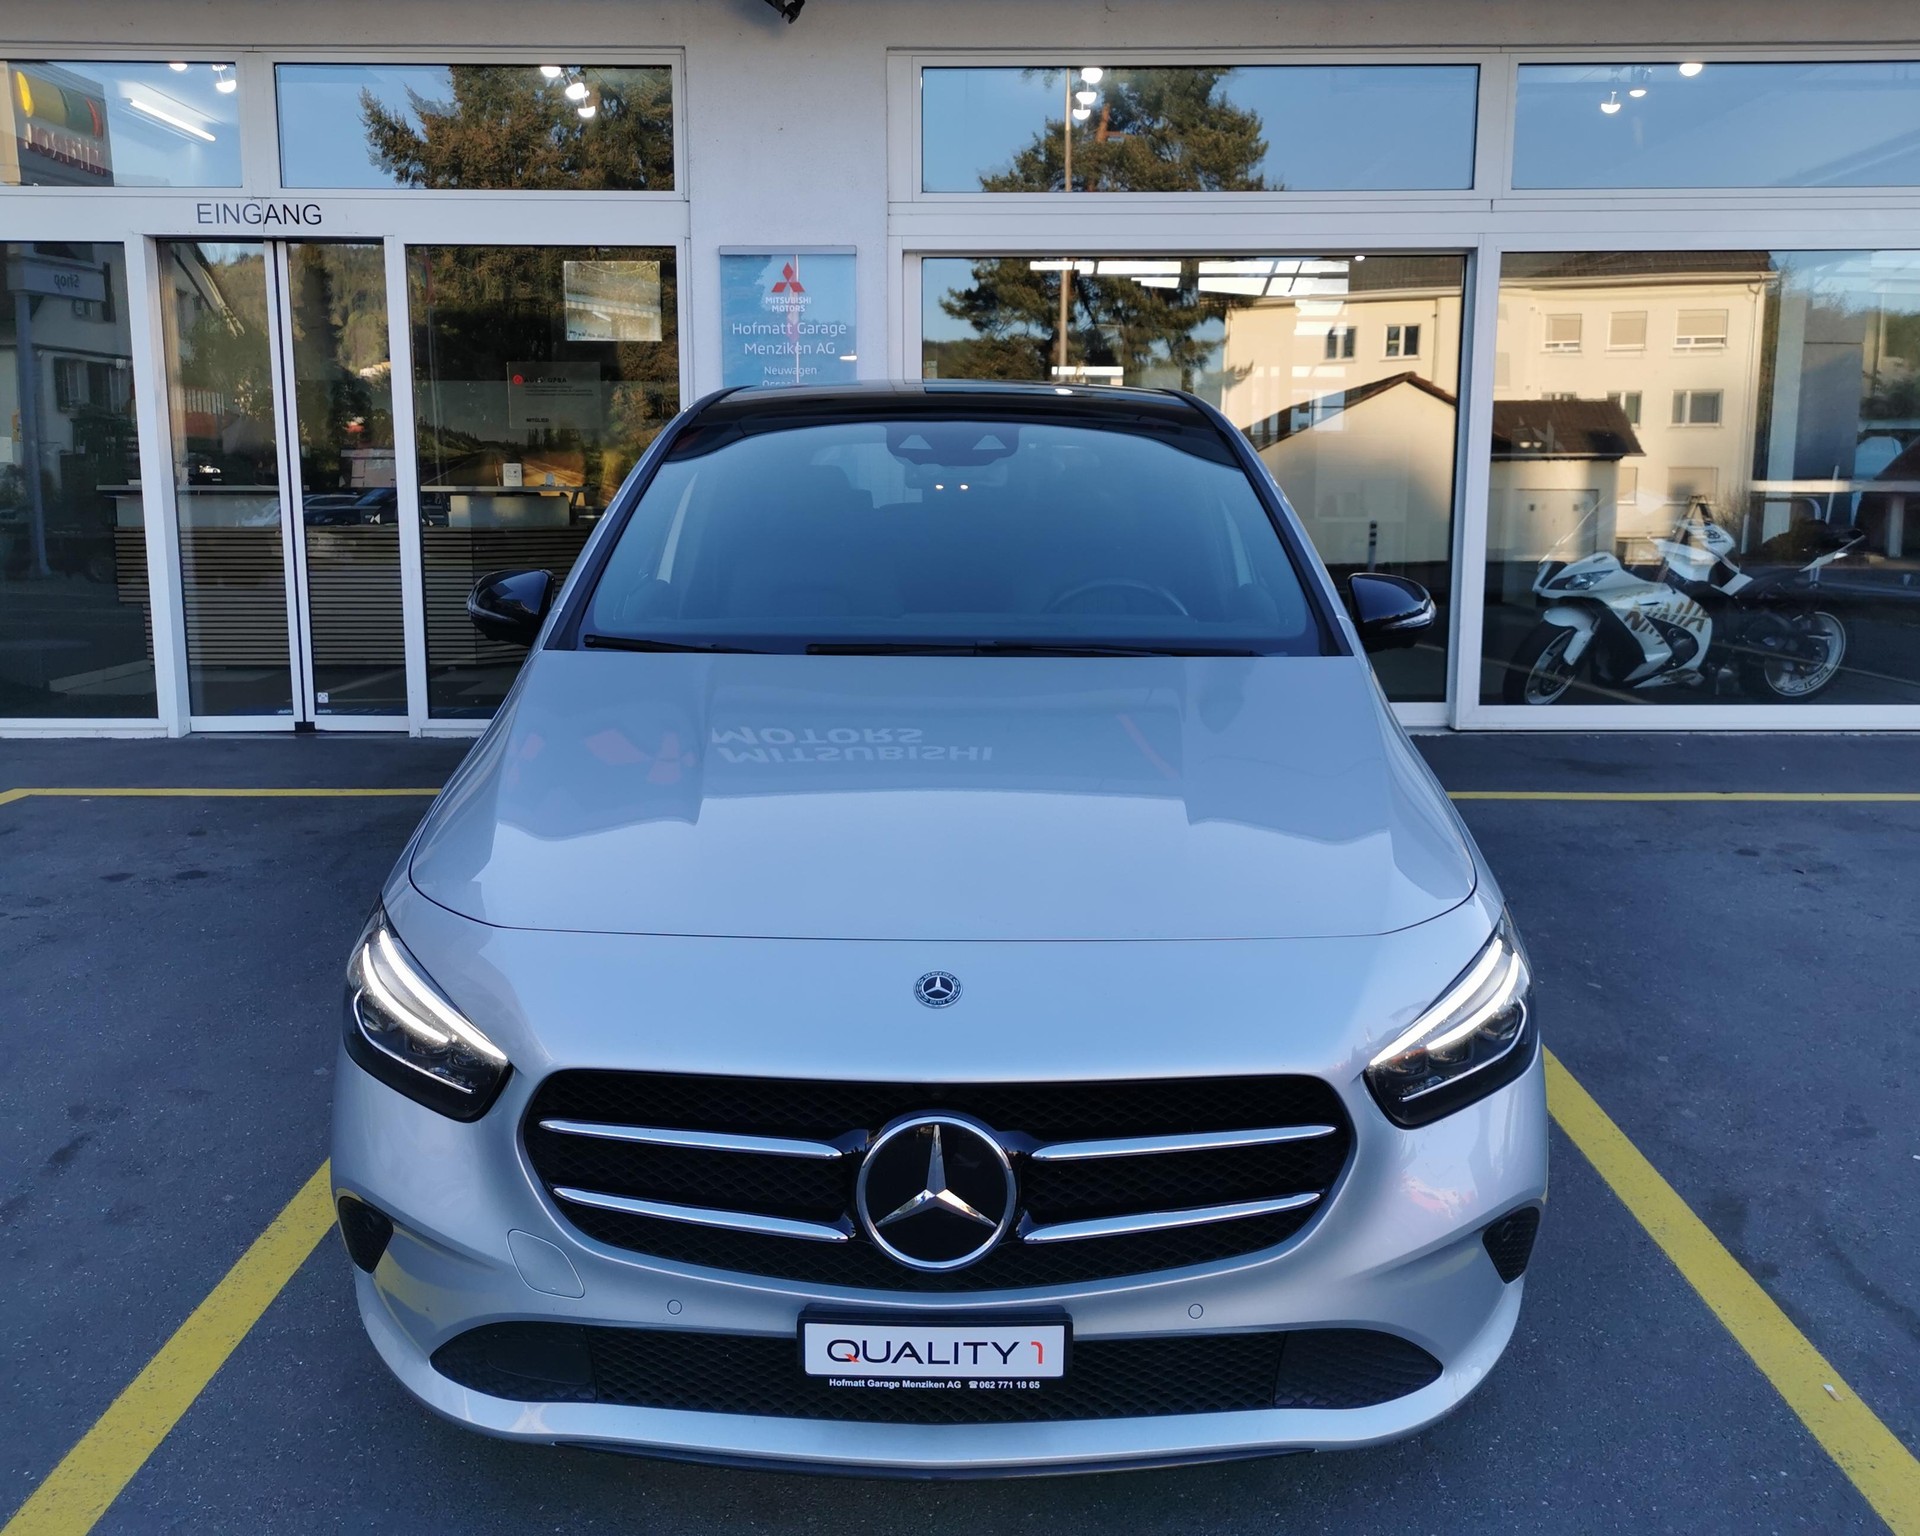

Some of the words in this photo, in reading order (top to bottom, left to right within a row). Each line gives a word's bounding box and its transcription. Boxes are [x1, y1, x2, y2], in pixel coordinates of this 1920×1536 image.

[196, 202, 322, 226] EINGANG
[765, 296, 812, 305] MITSUBISHI
[771, 304, 806, 313] MOTORS
[732, 321, 793, 336] Hofmatt
[797, 322, 847, 338] Garage
[744, 341, 812, 356] Menziken
[816, 342, 836, 355] AG
[763, 366, 818, 377] Neuwagen
[826, 1338, 1021, 1365] QUALITY
[1030, 1341, 1044, 1365] 1
[828, 1378, 866, 1388] Hofmatt
[867, 1379, 901, 1390] Garage
[902, 1380, 945, 1389] Menziken
[947, 1380, 962, 1389] AG
[979, 1380, 996, 1389] 062
[997, 1380, 1013, 1389] 771
[1016, 1380, 1027, 1389] 18
[1028, 1380, 1040, 1389] 65
